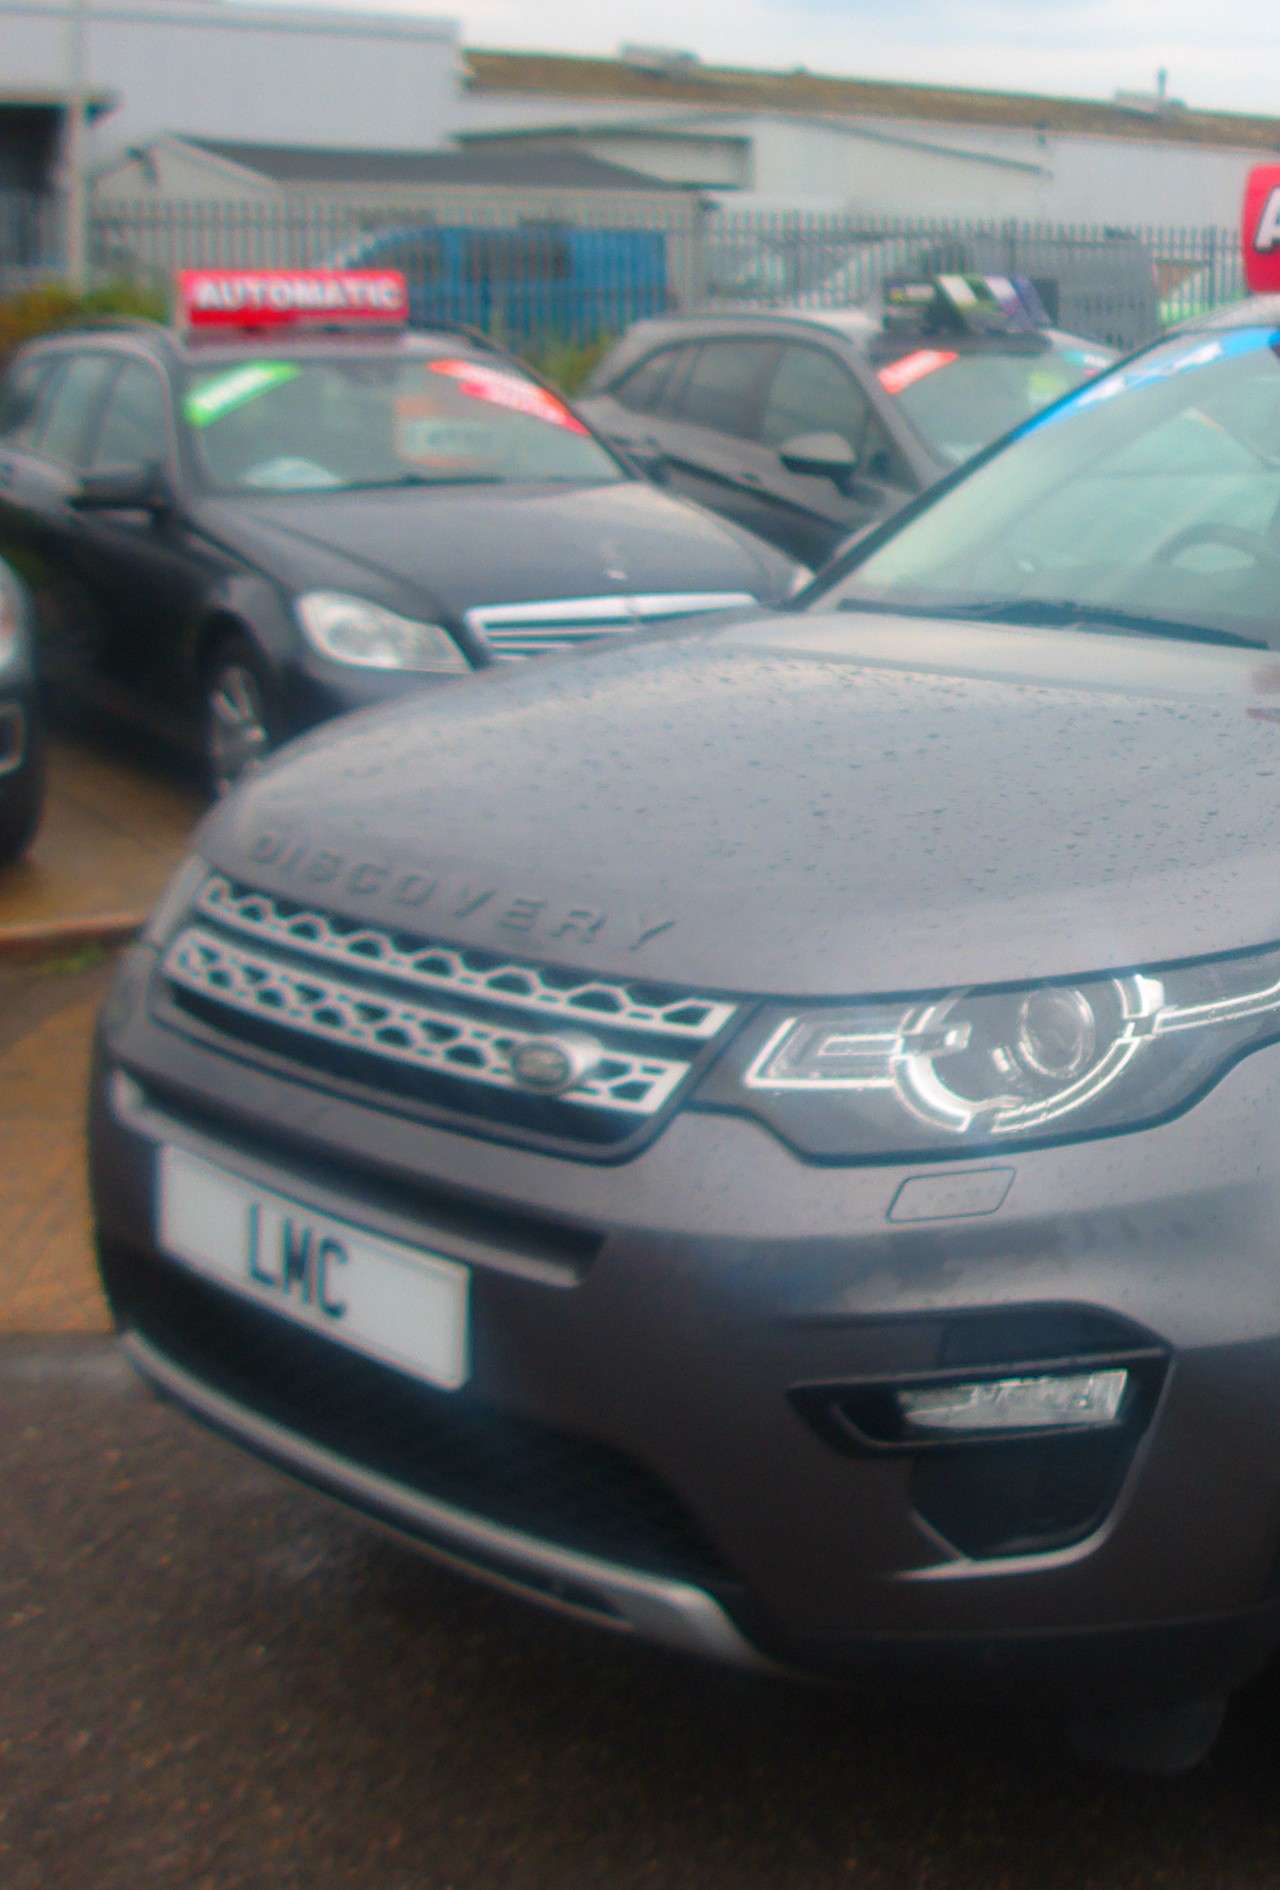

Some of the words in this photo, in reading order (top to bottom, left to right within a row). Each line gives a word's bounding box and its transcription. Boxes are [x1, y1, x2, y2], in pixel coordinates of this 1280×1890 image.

[196, 278, 402, 309] AUTOMATIC
[250, 832, 676, 953] DISCOVERY
[249, 1203, 349, 1319] LMC
